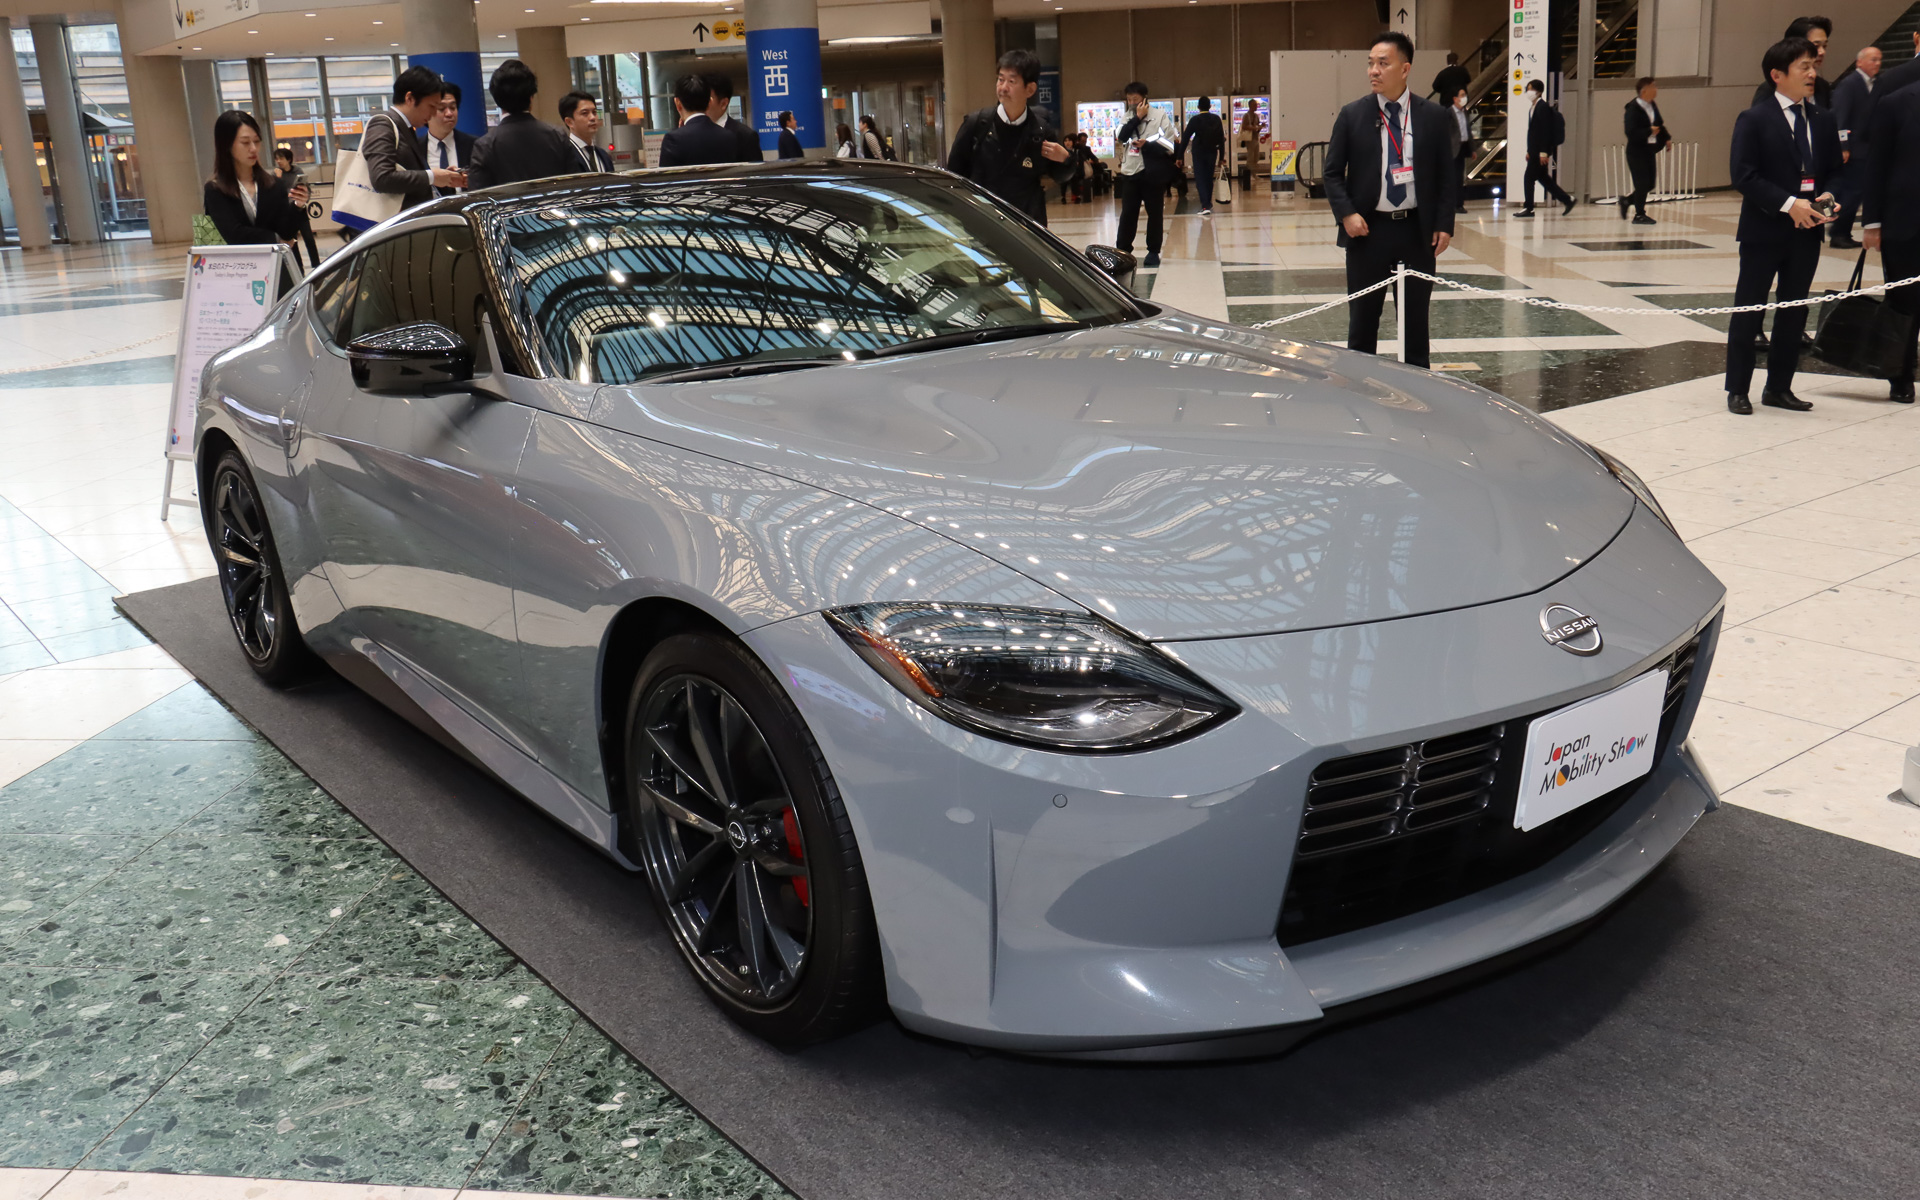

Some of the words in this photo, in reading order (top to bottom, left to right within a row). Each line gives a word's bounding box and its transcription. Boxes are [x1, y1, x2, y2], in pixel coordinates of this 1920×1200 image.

[762, 49, 788, 60] West
[764, 65, 789, 96] 西
[1039, 87, 1052, 103] 西
[1546, 617, 1597, 642] NISSAN
[1544, 734, 1591, 766] Japan
[1538, 753, 1606, 796] Mobility
[1607, 733, 1649, 763] Show
